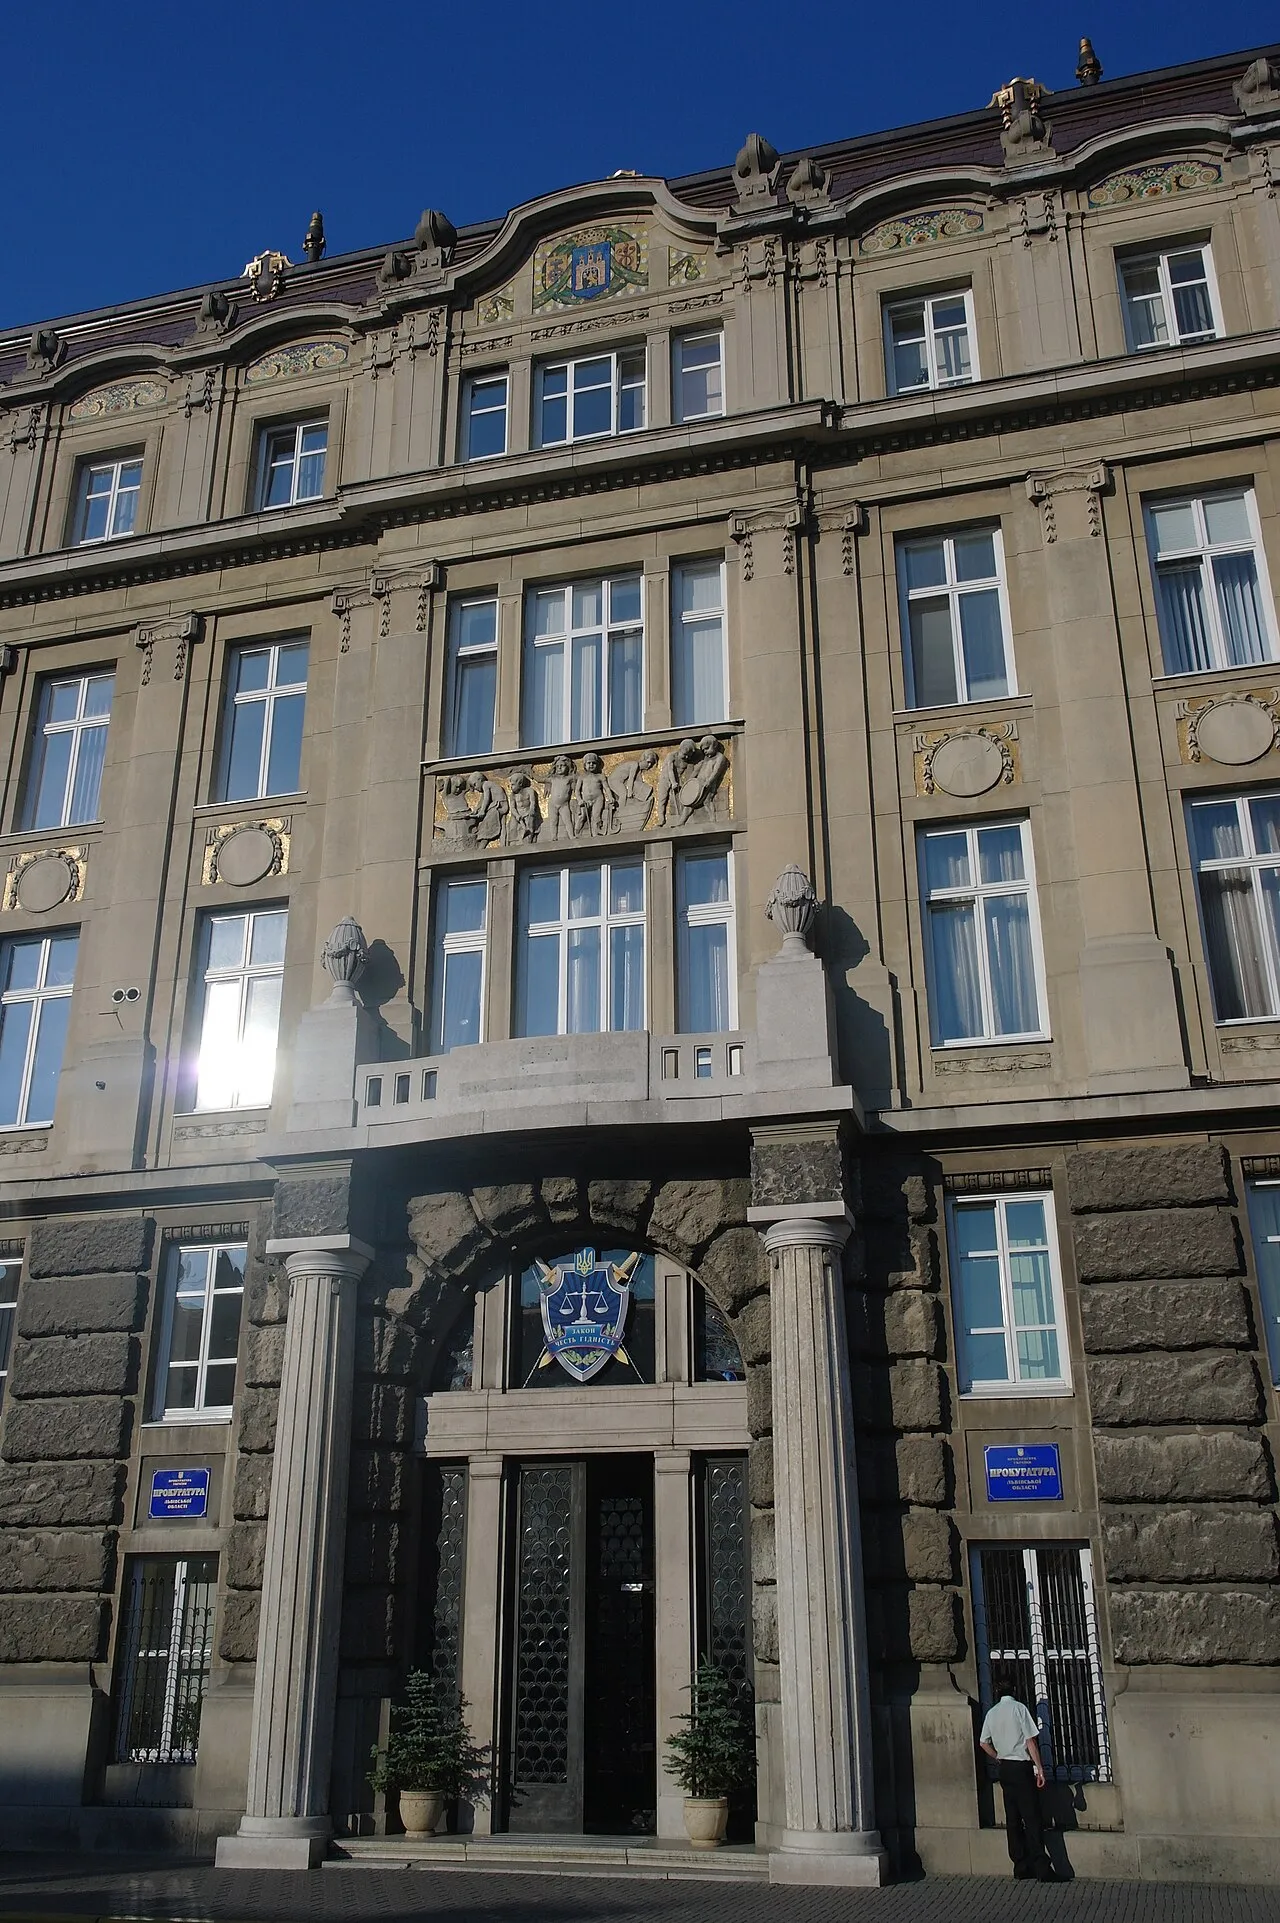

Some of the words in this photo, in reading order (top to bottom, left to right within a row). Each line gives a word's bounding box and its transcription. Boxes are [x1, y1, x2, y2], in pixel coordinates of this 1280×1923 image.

[555, 1336, 577, 1347] ЧЕСТЬ
[579, 1336, 615, 1346] ГІДНІСТЬ
[989, 1467, 1056, 1478] ПРОКУРАТУРА
[153, 1488, 205, 1497] ПРОКУРАТУРА
